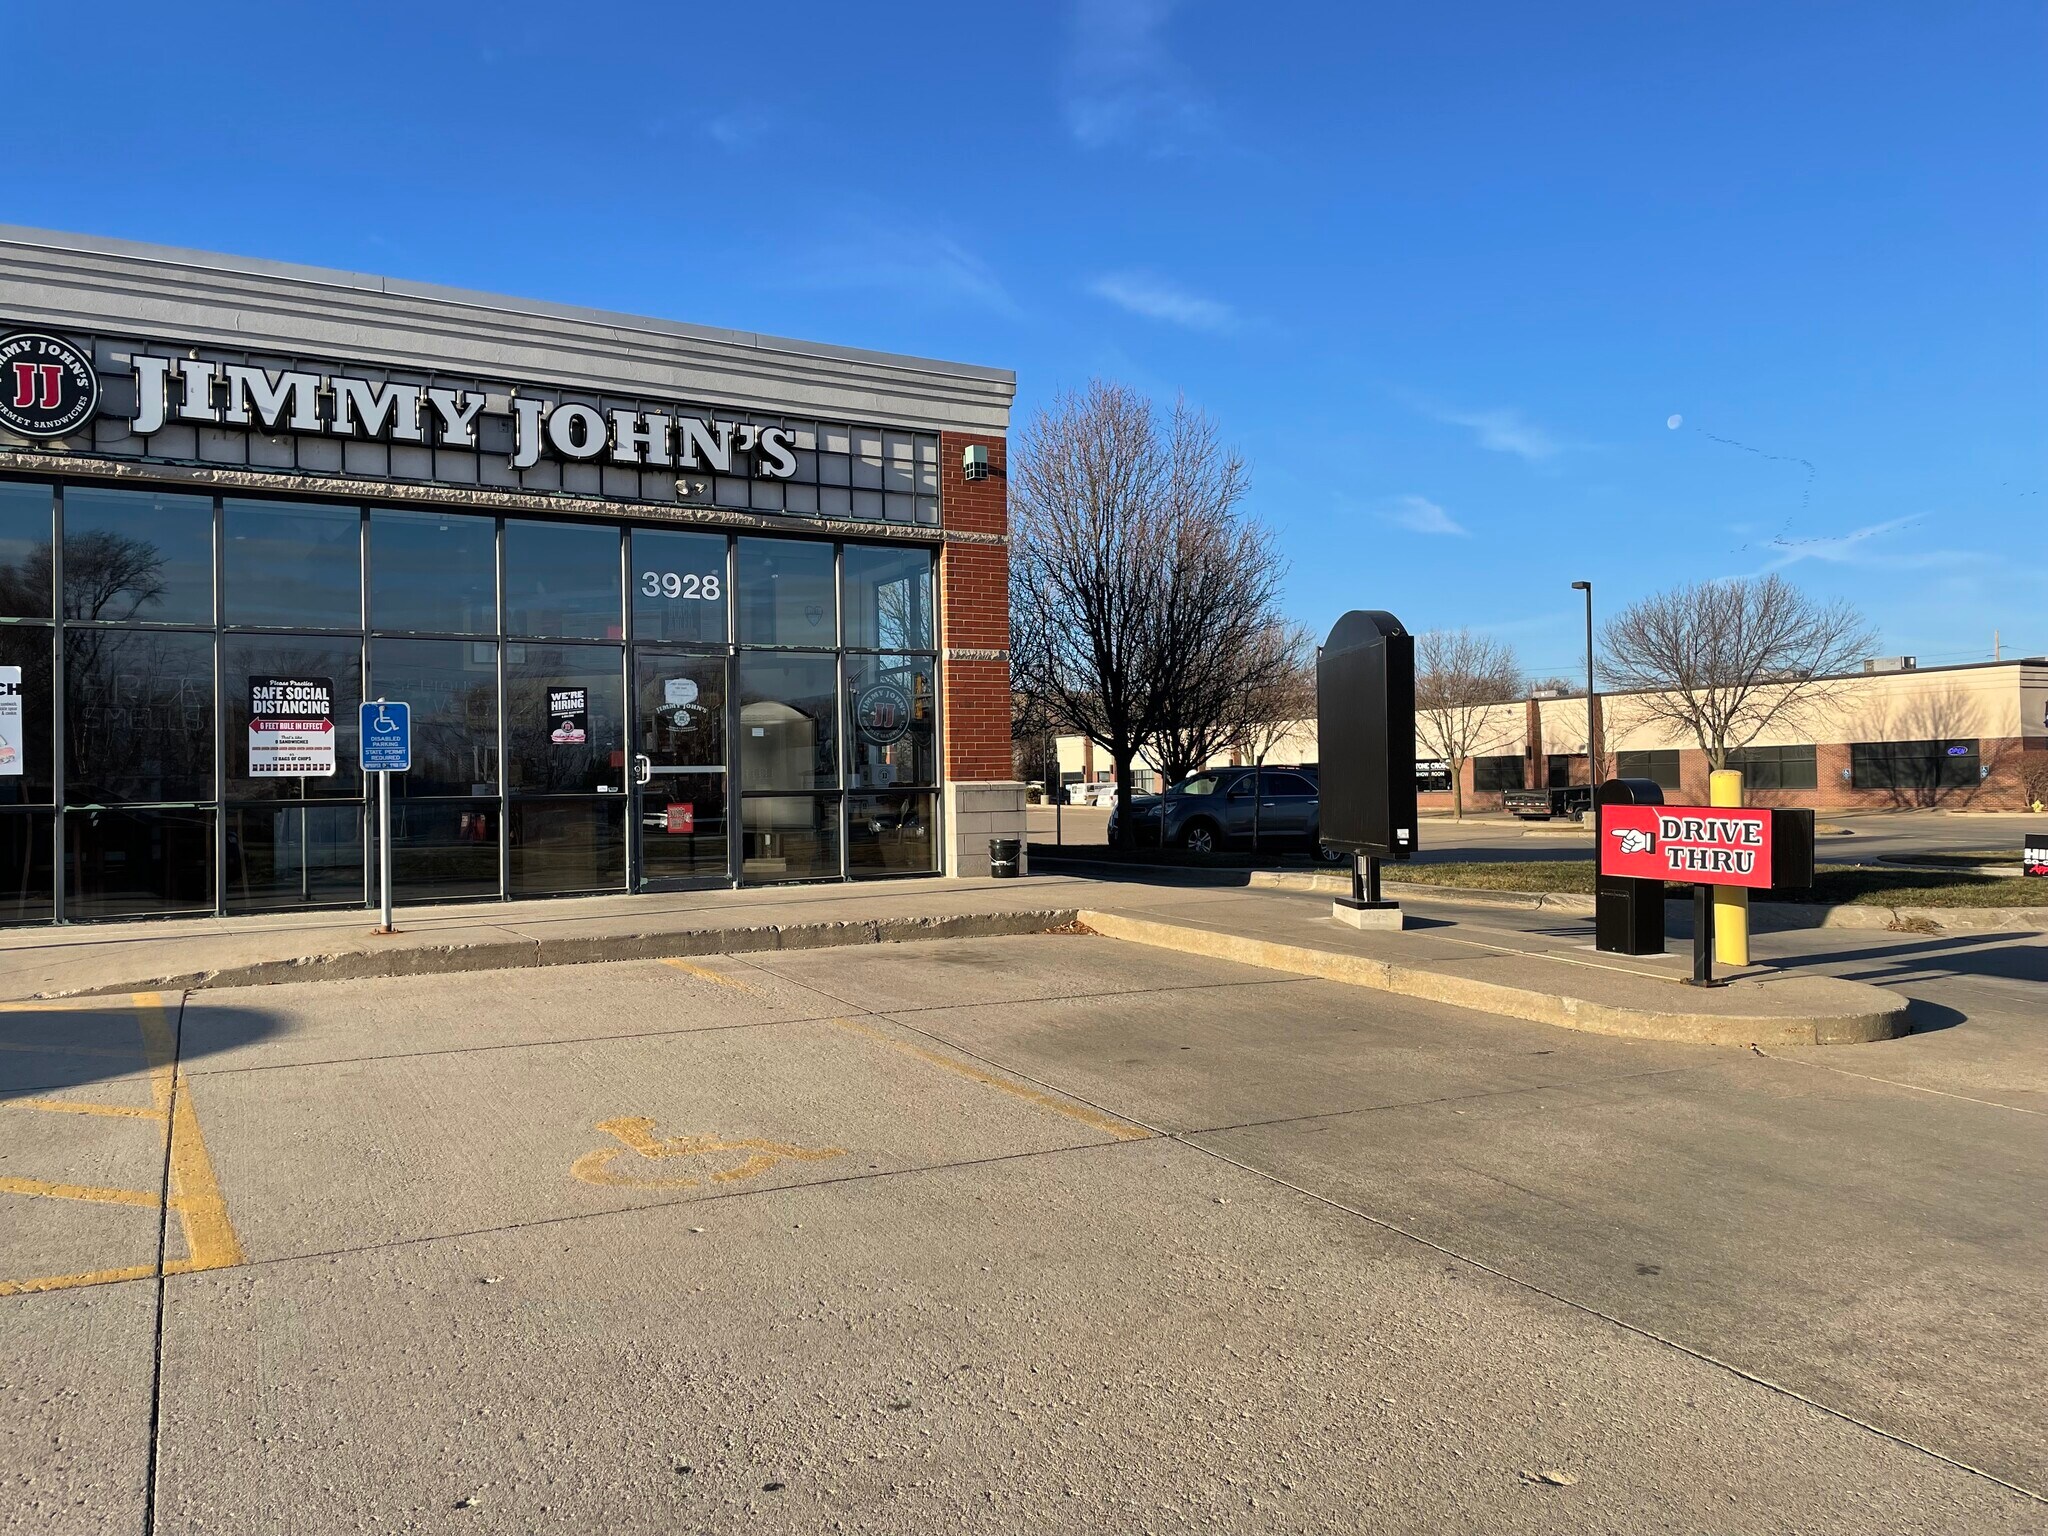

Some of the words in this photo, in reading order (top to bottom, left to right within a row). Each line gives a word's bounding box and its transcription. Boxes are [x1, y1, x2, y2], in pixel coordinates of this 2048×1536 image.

[39, 341, 89, 387] JOHN'S
[13, 362, 64, 409] JJ
[34, 395, 88, 428] SANDWICHES
[131, 354, 486, 447] JIMMY
[510, 398, 798, 479] JOHN'S
[641, 571, 721, 601] 3928
[253, 687, 283, 700] SAFE
[286, 687, 330, 700] SOCIAL
[551, 690, 585, 701] WE'RE
[551, 699, 585, 711] HIRING
[862, 690, 884, 713] JIMMY
[253, 700, 330, 714] DISTANCING
[656, 703, 680, 714] JIMMY
[873, 702, 896, 728] JJ
[1949, 747, 1965, 755] OPEN
[1660, 817, 1762, 845] DRIVE
[1667, 846, 1754, 874] THRU
